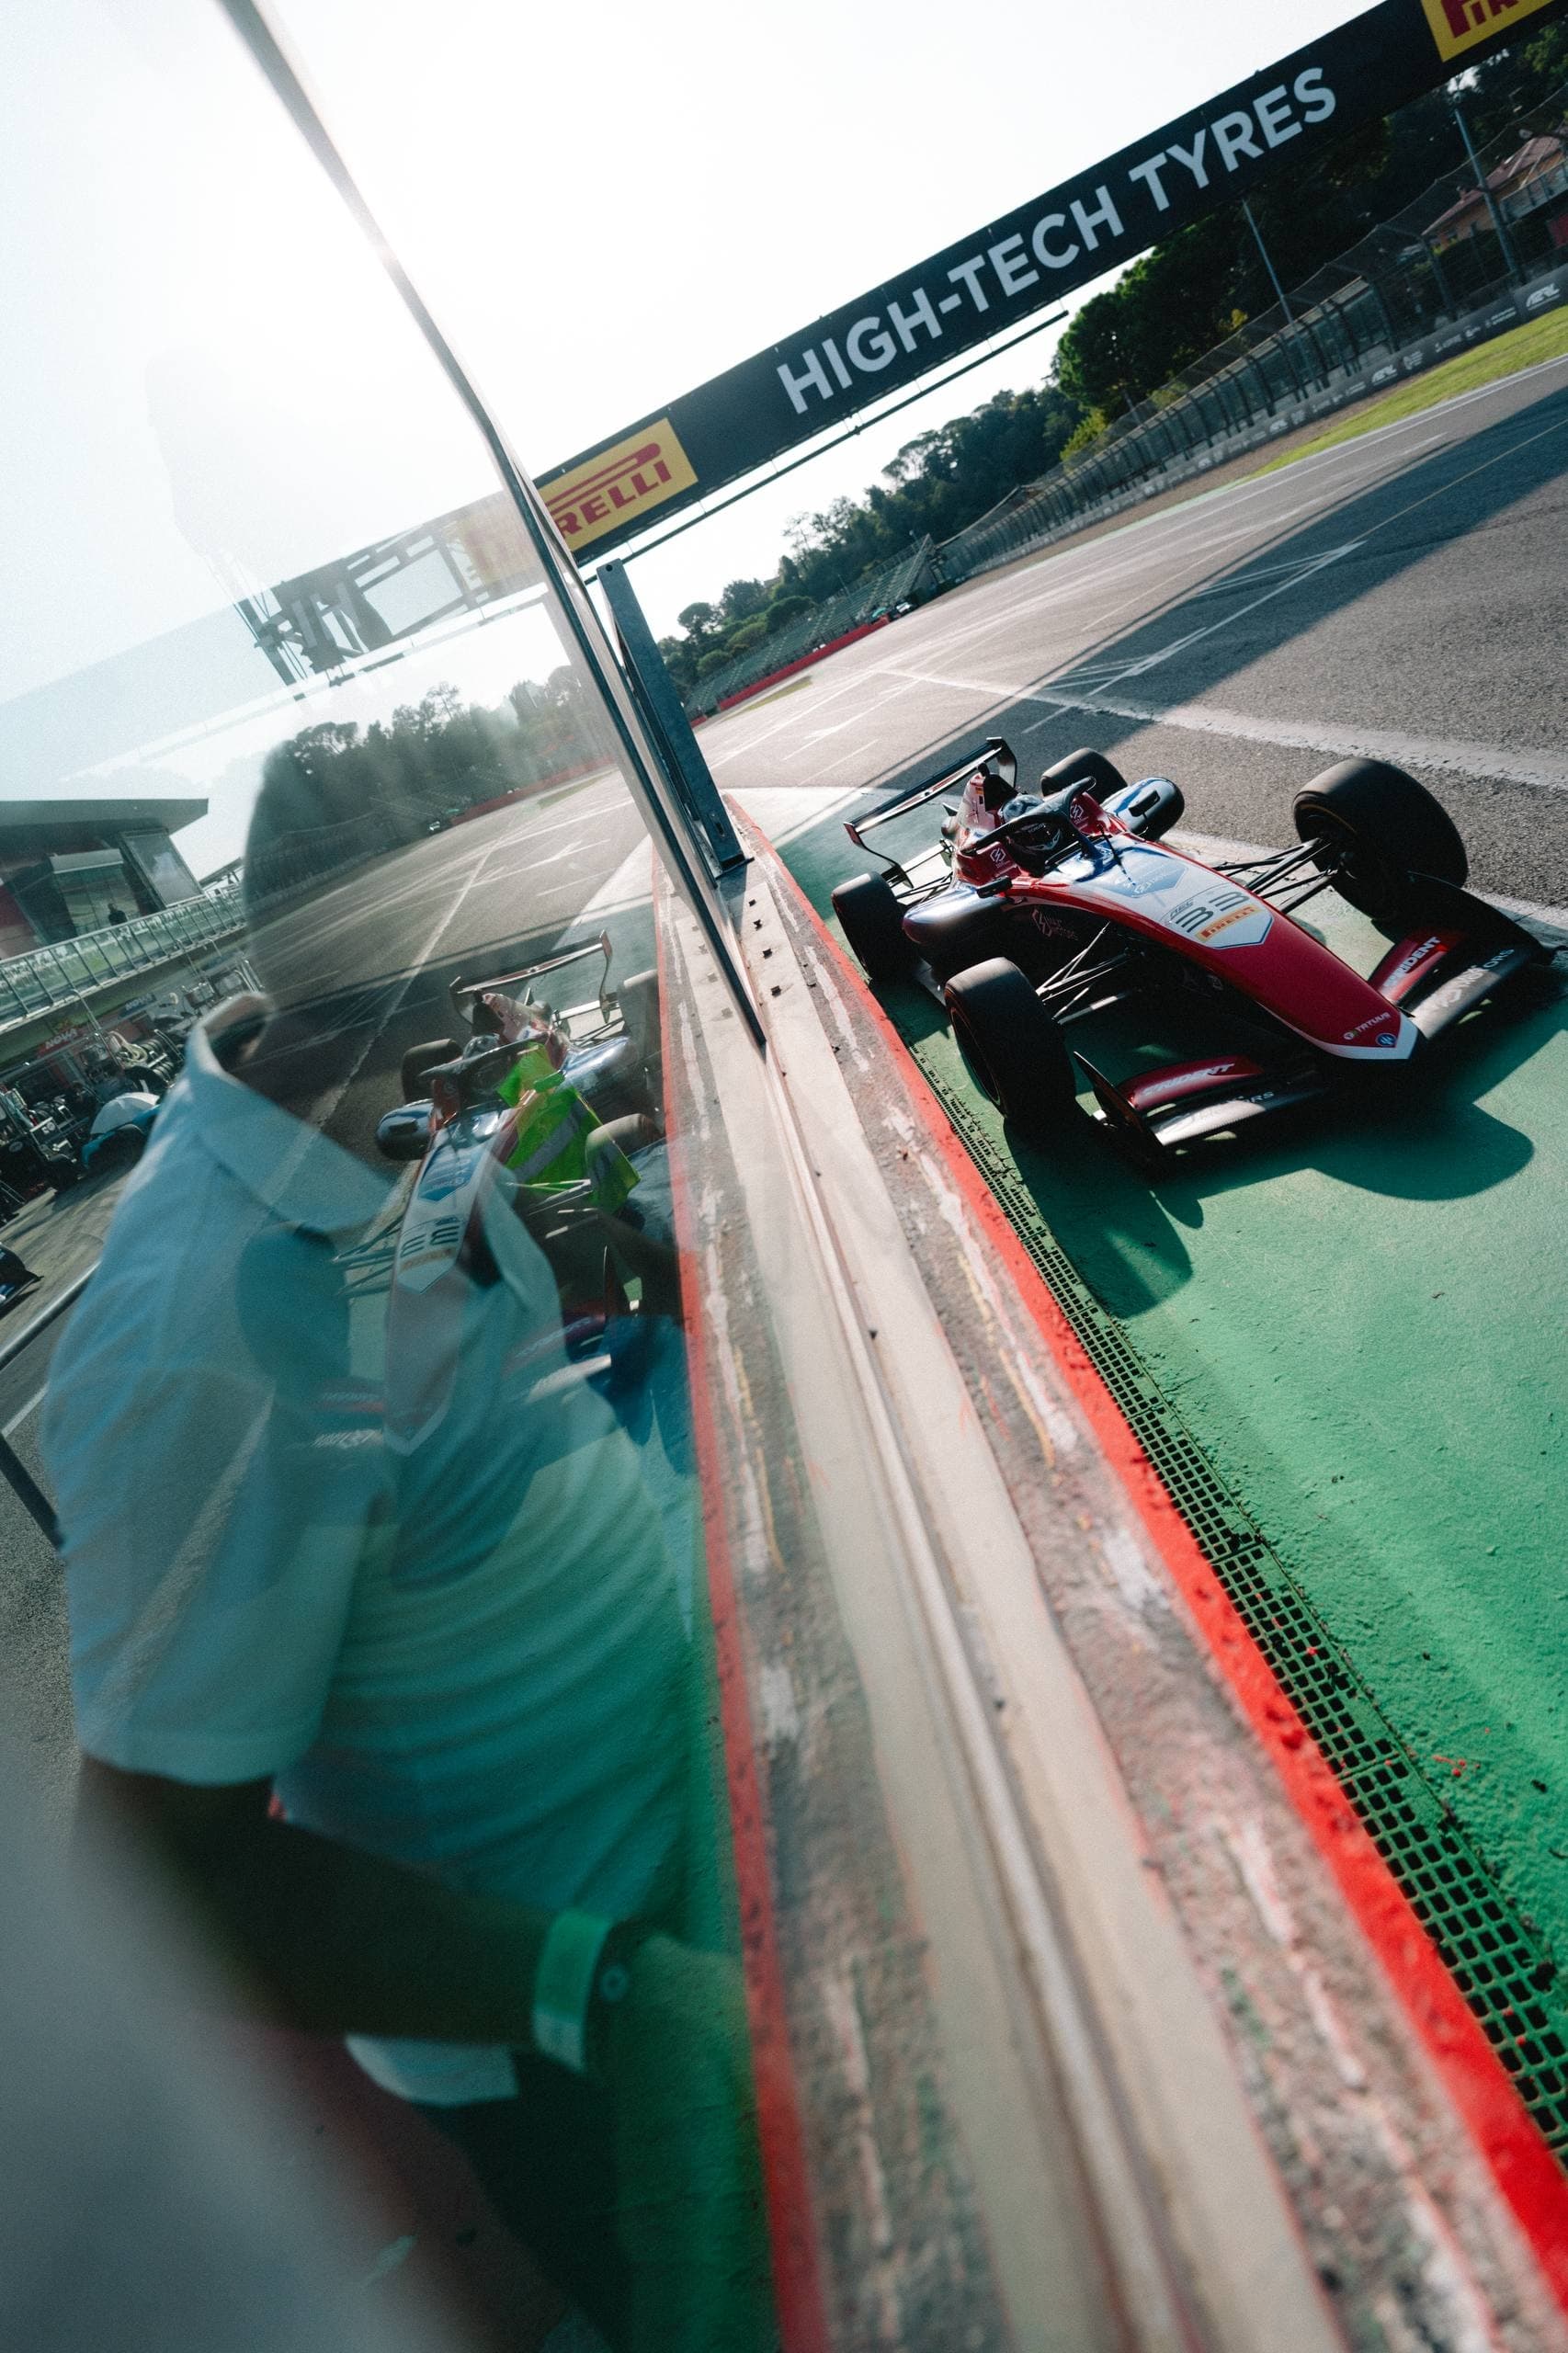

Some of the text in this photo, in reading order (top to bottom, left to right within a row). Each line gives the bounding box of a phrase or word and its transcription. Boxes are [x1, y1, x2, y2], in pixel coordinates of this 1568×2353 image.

[777, 67, 1336, 414] HIGH-TECH TYRES
[555, 460, 672, 539] RELLI
[1176, 892, 1249, 933] 33
